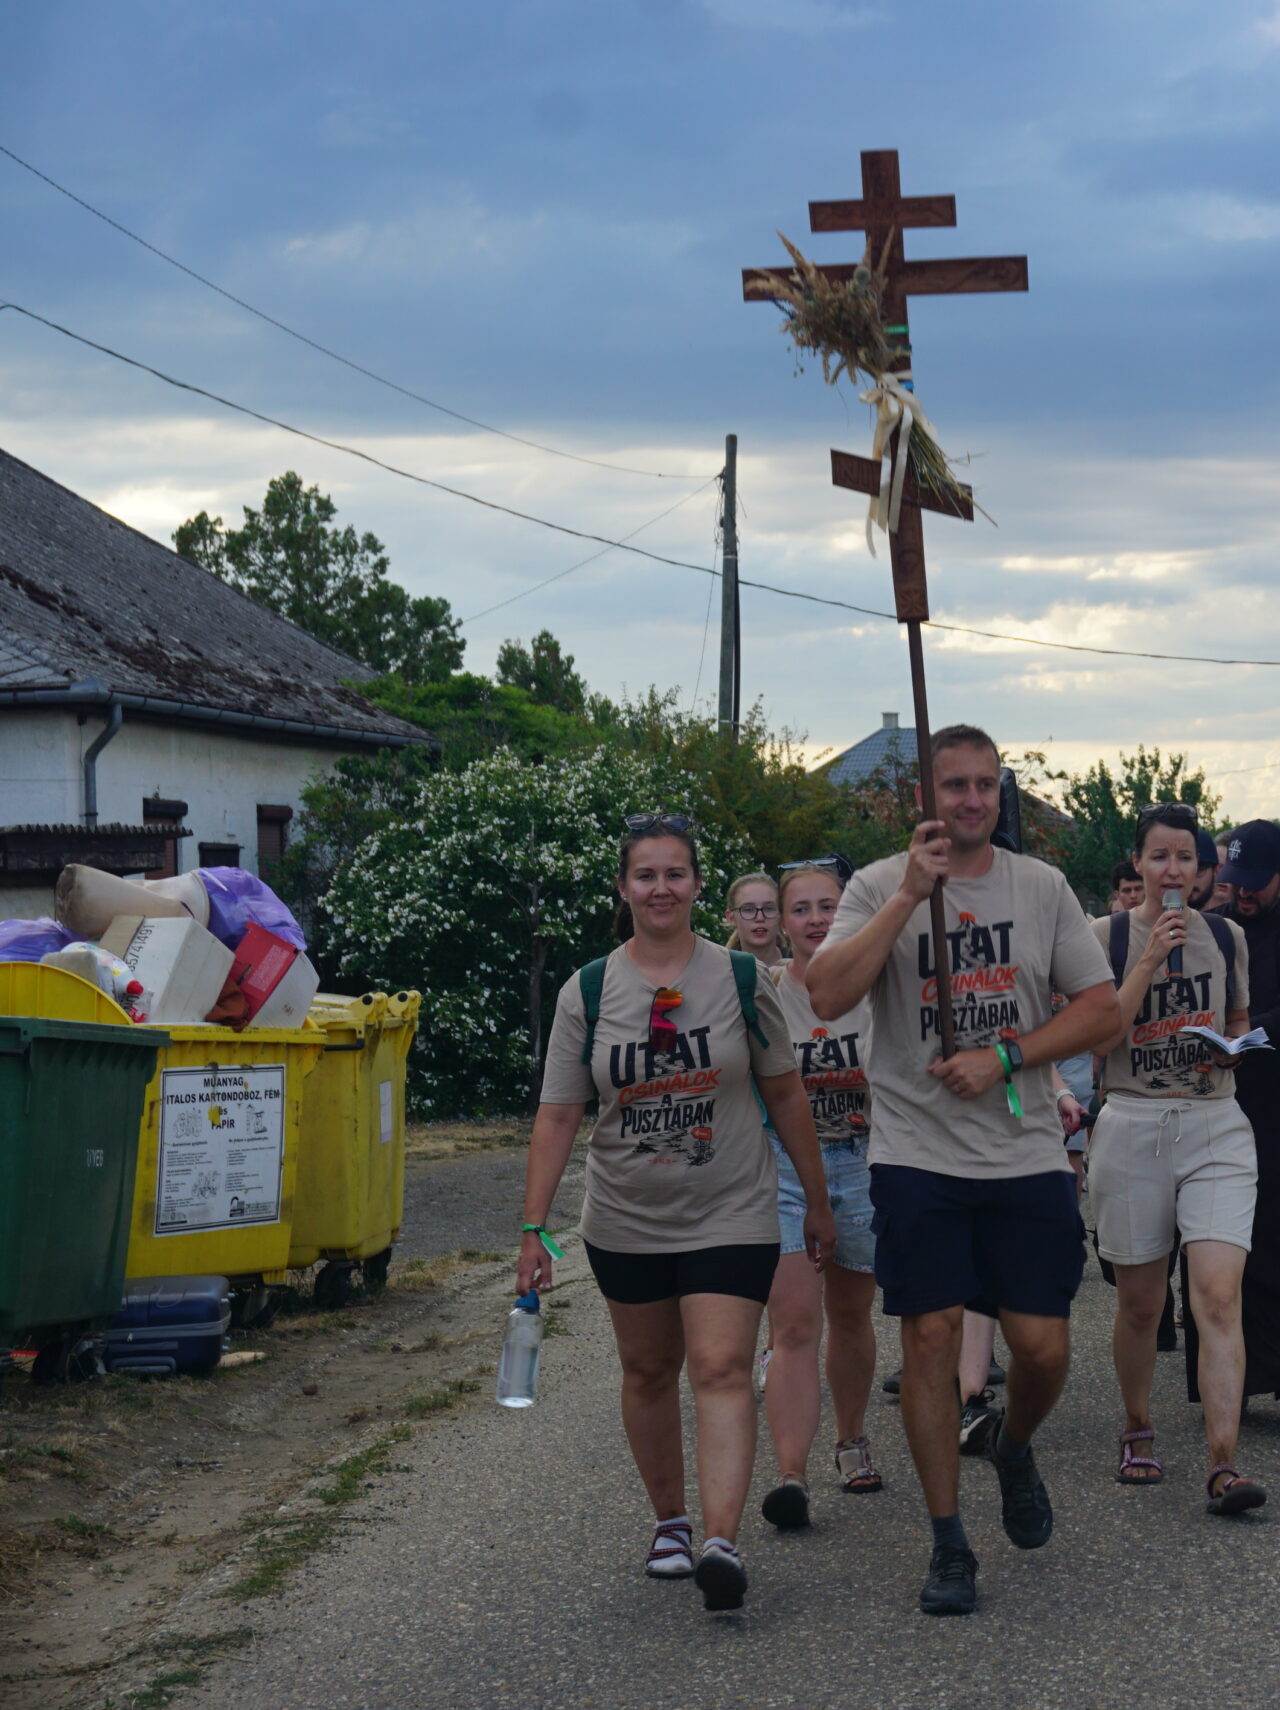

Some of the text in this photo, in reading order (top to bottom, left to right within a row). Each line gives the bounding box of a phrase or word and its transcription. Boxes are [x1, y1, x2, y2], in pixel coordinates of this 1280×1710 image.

[918, 921, 1014, 979] UTAT
[921, 965, 1020, 1003] CINÁLOK
[965, 992, 976, 1004] A
[1131, 1010, 1216, 1045] CSINÁLOK
[1168, 1035, 1178, 1046] A
[609, 1026, 711, 1089] UTAT
[793, 1032, 859, 1077] TAT
[167, 1094, 196, 1105] ITALOS
[618, 1068, 722, 1105] CSINÁLOK
[661, 1094, 672, 1107] A
[620, 1099, 715, 1138] PUSZTÁBAN
[811, 1092, 866, 1119] ZTÁBAN
